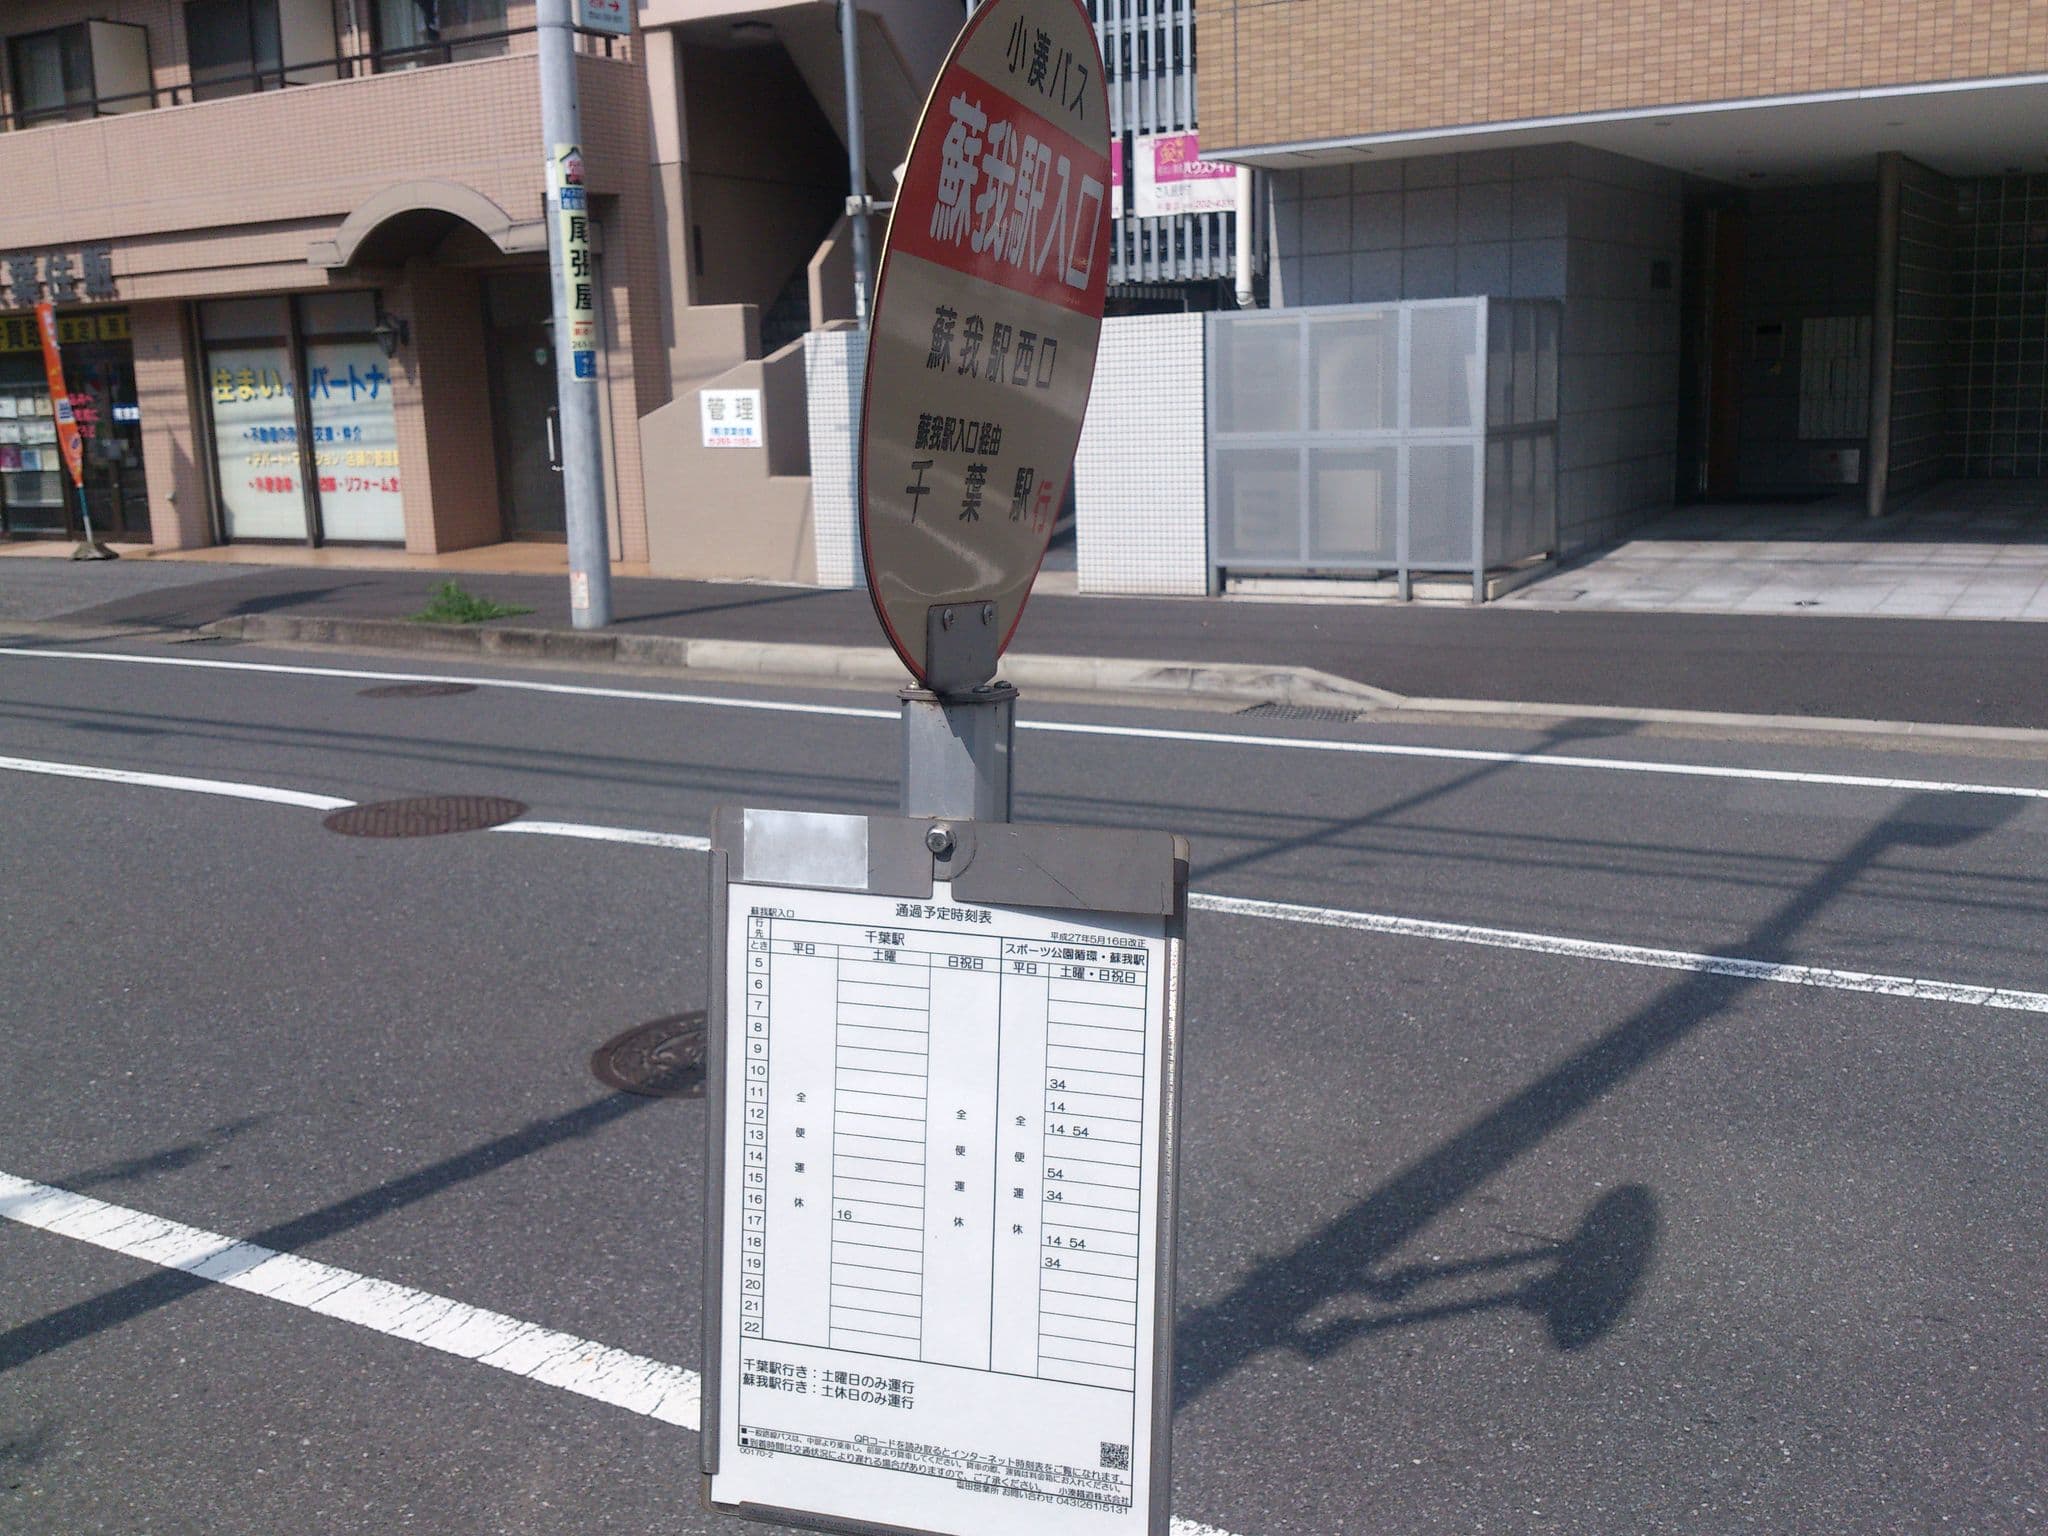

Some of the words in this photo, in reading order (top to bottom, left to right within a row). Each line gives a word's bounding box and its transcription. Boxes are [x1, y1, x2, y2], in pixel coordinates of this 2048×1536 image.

[1007, 15, 1088, 120] 小湊バス
[930, 91, 1104, 291] 蘇我駅入口
[927, 305, 1057, 388] 蘇我駅西口
[915, 412, 1002, 455] 蘇我駅入口経由
[751, 906, 795, 919] 蘇我駅入口
[896, 903, 992, 924] 通過予定時刻表
[755, 918, 764, 937] 行先
[865, 930, 905, 946] 千葉駅
[1050, 931, 1146, 948] 平成27年5月16日改正
[750, 940, 767, 950] とき
[793, 942, 816, 955] 平日
[873, 949, 897, 962] 土曜
[1005, 943, 1145, 966] スポーツ公園循環・蘇我駅
[755, 957, 763, 967] 5
[948, 956, 984, 970] 日祝日
[1013, 962, 1037, 975] 平日
[1060, 965, 1136, 984] 土曜・日祝日
[754, 979, 763, 989] 6
[754, 1001, 762, 1010] 7
[754, 1022, 762, 1032] 8
[753, 1044, 762, 1054] 9
[751, 1065, 765, 1075] 10
[1050, 1079, 1066, 1089] 34
[750, 1087, 763, 1097] 11
[1050, 1101, 1066, 1112] 14
[750, 1108, 764, 1119] 12
[749, 1130, 764, 1140] 13
[1050, 1124, 1065, 1134] 14
[1072, 1126, 1089, 1137] 54
[749, 1152, 763, 1161] 14
[749, 1173, 763, 1183] 15
[1047, 1168, 1063, 1179] 54
[748, 1194, 762, 1204] 16
[1046, 1190, 1063, 1201] 34
[748, 1215, 762, 1225] 17
[837, 1210, 852, 1220] 16
[747, 1237, 761, 1247] 18
[1047, 1236, 1062, 1246] 14
[1069, 1238, 1086, 1249] 54
[746, 1258, 761, 1268] 19
[1045, 1258, 1061, 1268] 34
[745, 1280, 761, 1290] 20
[744, 1301, 759, 1311] 21
[744, 1322, 760, 1333] 22
[743, 1358, 914, 1394] 千葉駅行き：土曜日のみ運行
[742, 1373, 914, 1410] 蘇我駅行き：土休日のみ運行
[740, 1447, 774, 1459] 00170-2
[1002, 1487, 1053, 1504] お問い合わせ
[1056, 1497, 1128, 1515] 043(261)5131
